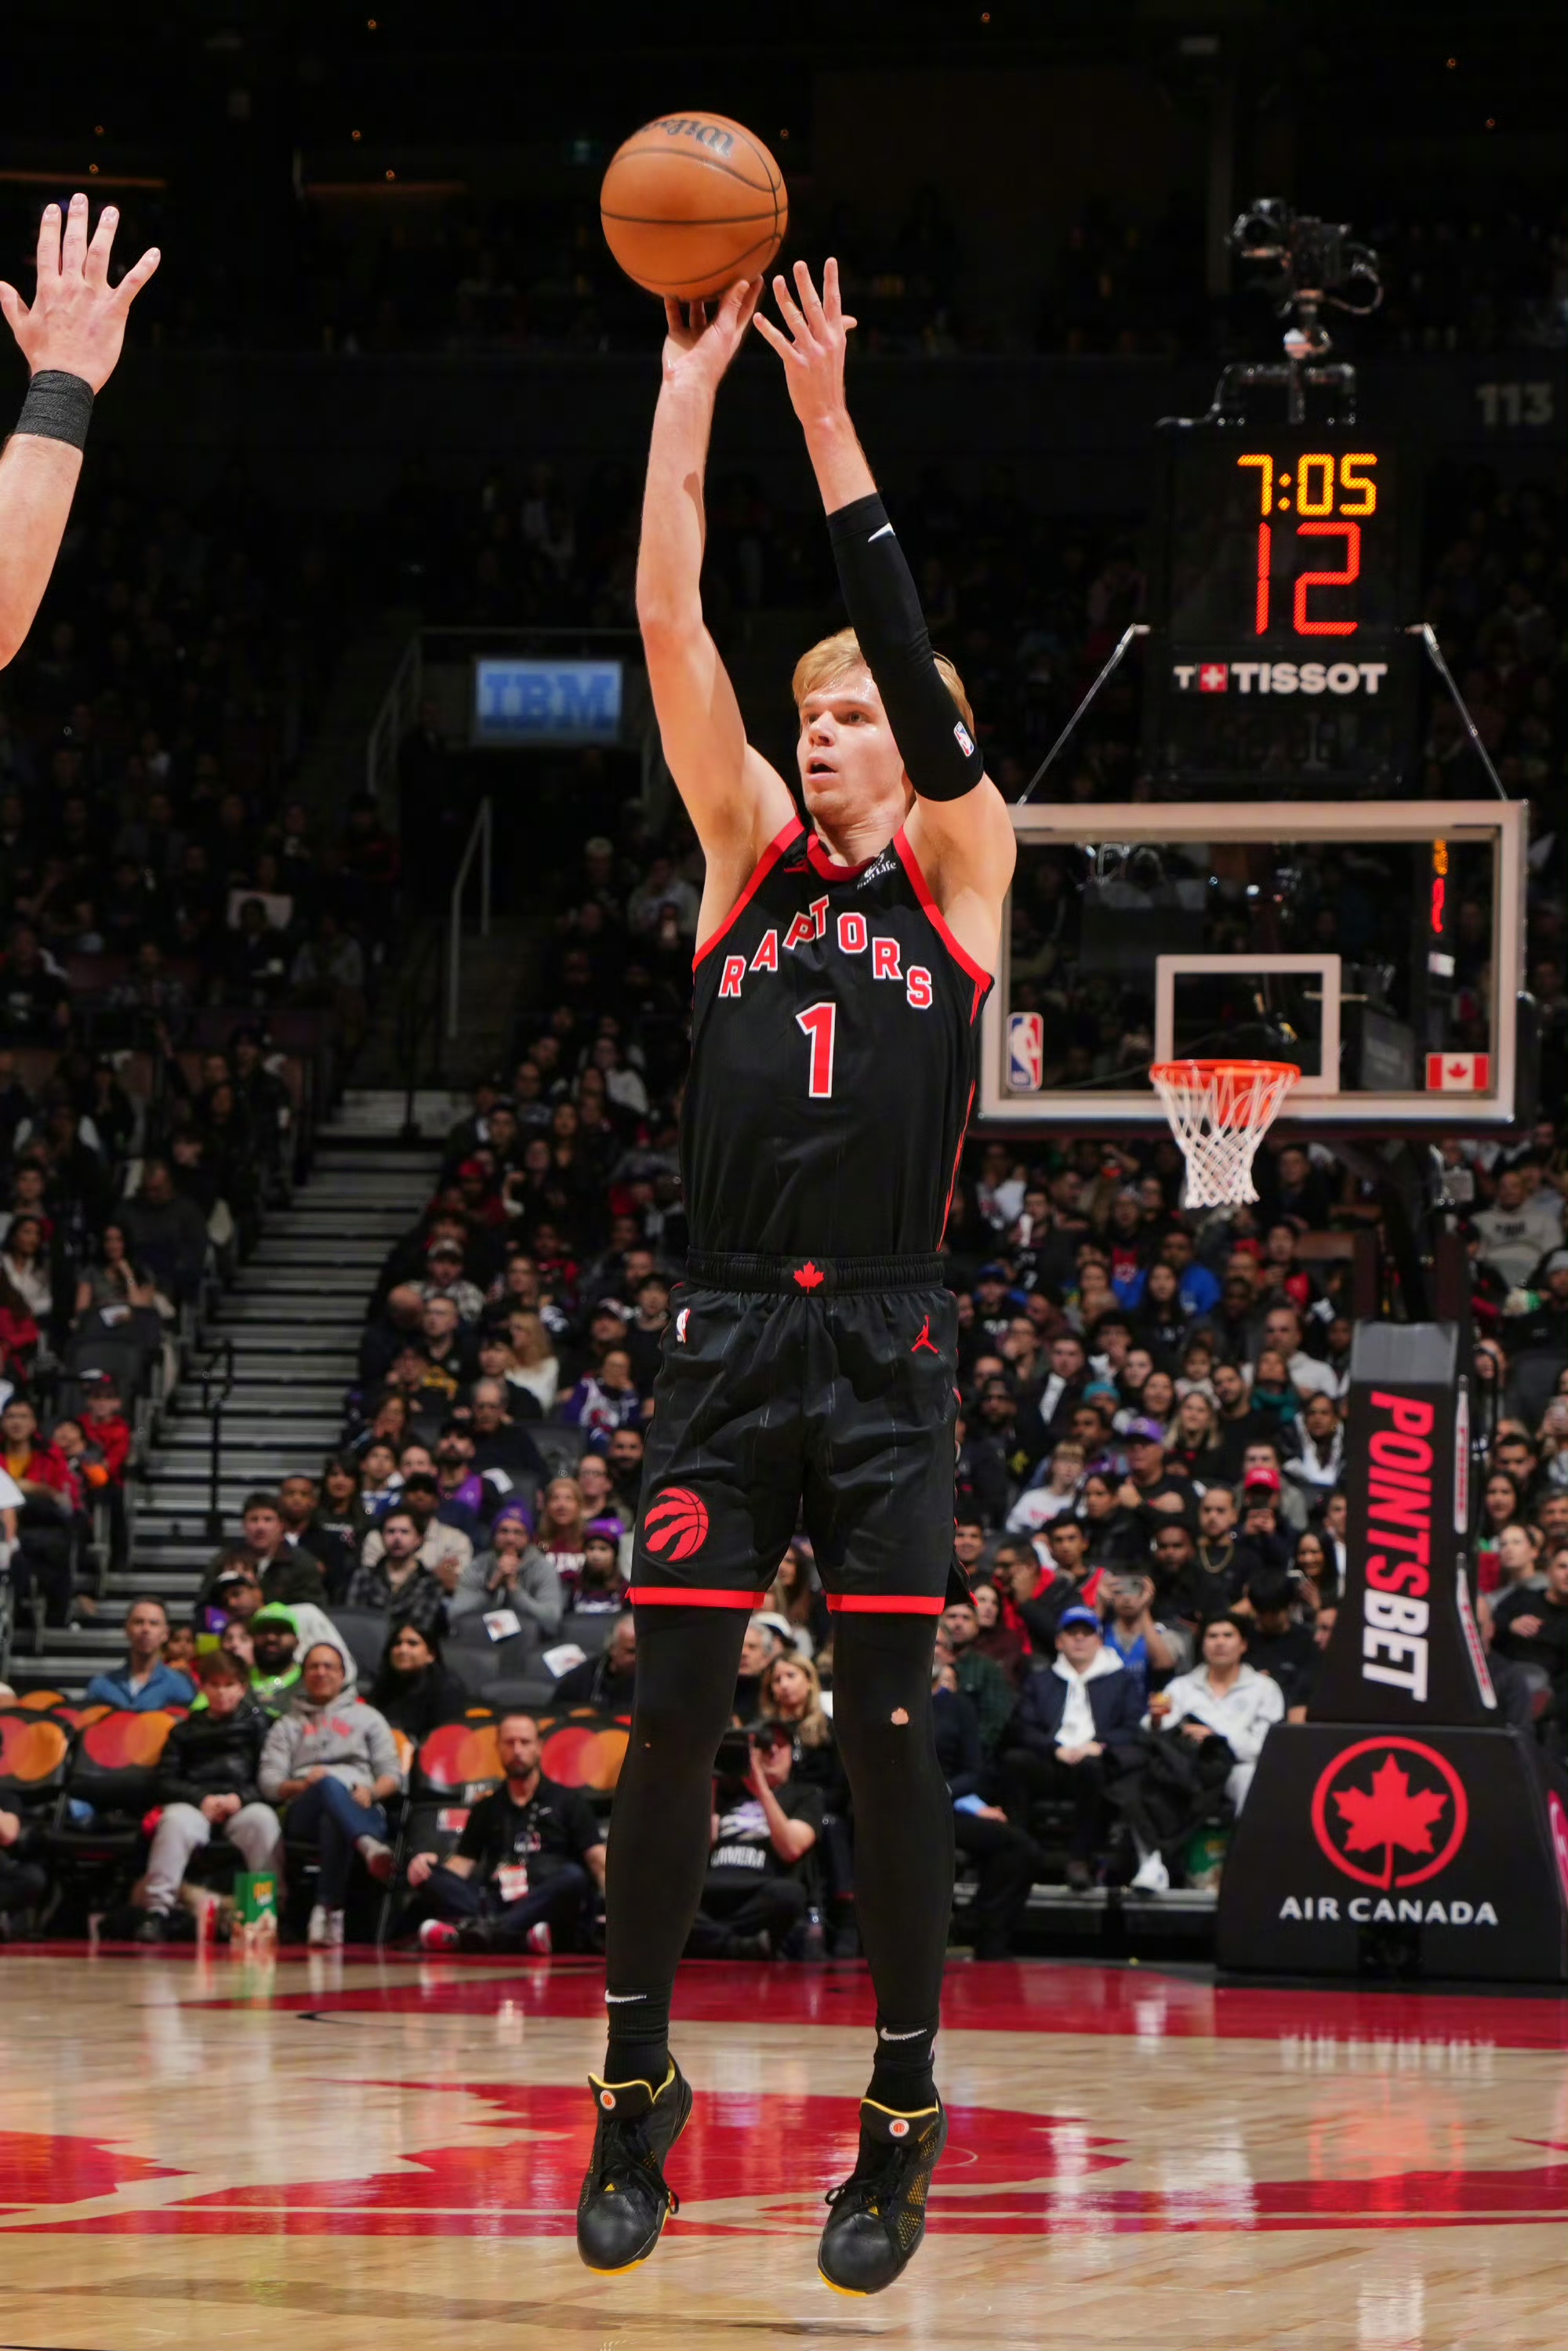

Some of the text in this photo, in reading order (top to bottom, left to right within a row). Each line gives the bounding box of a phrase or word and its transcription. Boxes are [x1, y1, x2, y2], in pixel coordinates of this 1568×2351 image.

[1477, 383, 1554, 426] 113
[1237, 453, 1377, 516] 7:05
[1256, 521, 1361, 635] 12
[485, 673, 615, 729] IBM
[1232, 662, 1388, 694] TISSOT
[876, 860, 898, 876] Life
[718, 894, 933, 1010] RAPTORS
[795, 1002, 837, 1098] 1
[1361, 1389, 1435, 1703] POINTSBET
[1279, 1896, 1499, 1925] AIR CANADA
